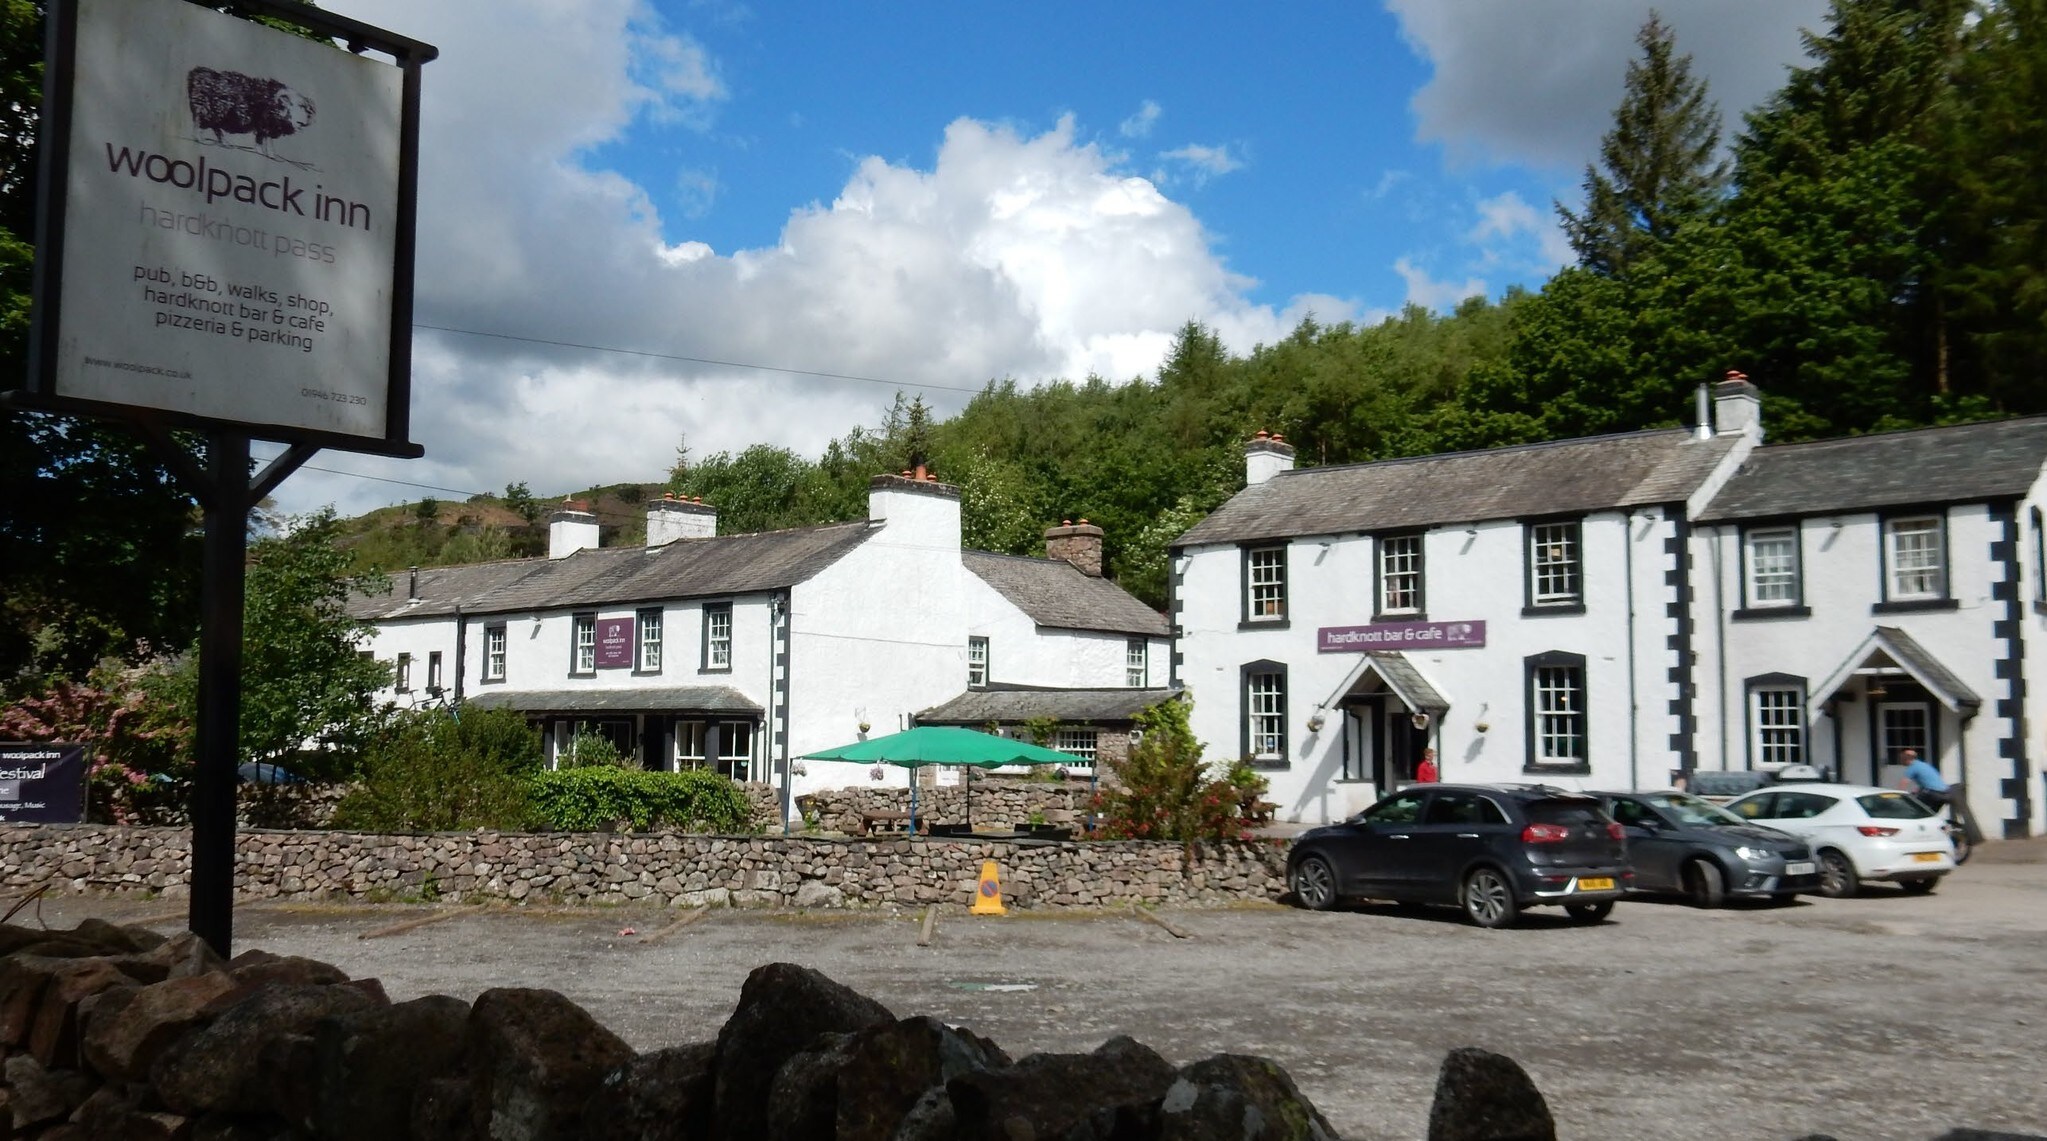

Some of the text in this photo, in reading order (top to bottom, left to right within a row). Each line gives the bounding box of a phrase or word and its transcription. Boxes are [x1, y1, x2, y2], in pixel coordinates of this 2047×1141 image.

[105, 142, 371, 231] woolpack inn
[139, 200, 337, 264] hardknott pass
[134, 265, 334, 317] pub, b&b, walks, shop,
[144, 285, 326, 333] hardknott bar & cafe
[155, 310, 314, 353] pizzeria & parking
[1327, 627, 1443, 644] hardknott bar & cafe
[2, 751, 45, 760] woolpack
